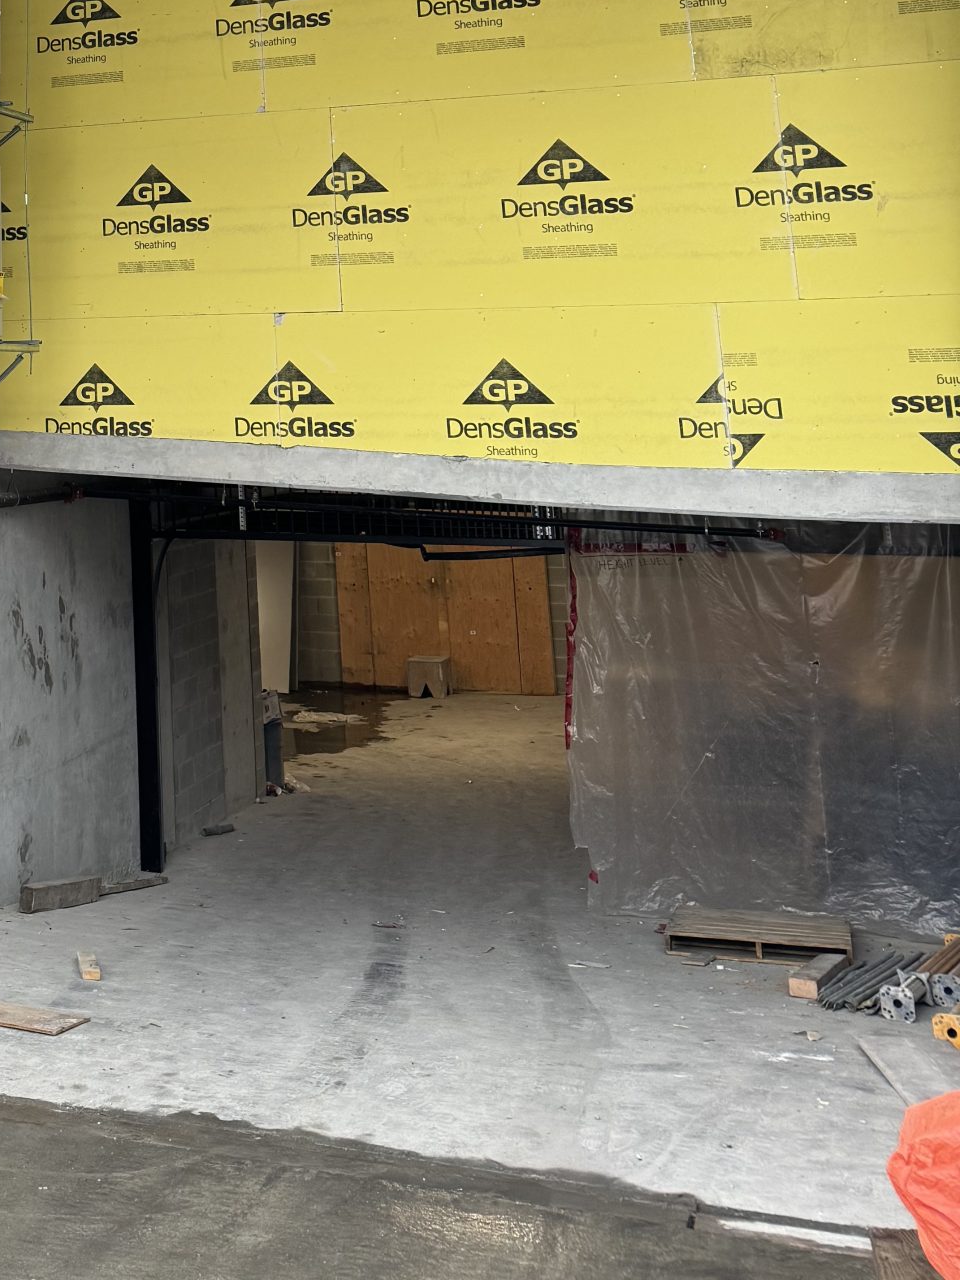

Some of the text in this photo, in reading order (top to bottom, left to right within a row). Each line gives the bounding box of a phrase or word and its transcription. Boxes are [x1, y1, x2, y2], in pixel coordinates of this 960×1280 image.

[65, 0, 103, 21] GP
[216, 10, 331, 37] DensGlass
[454, 15, 503, 29] Sheathing
[37, 30, 138, 54] DensGlass
[66, 53, 107, 65] Sheathing
[773, 144, 819, 166] GP
[536, 158, 584, 180] GP
[325, 170, 366, 192] GP
[132, 182, 172, 203] GP
[735, 183, 873, 208] DensGlass
[292, 205, 409, 228] DensGlass
[501, 194, 633, 219] DensGlass
[103, 216, 210, 236] DensGlass
[541, 221, 594, 234] Sheathing
[134, 239, 176, 250] Sheathing
[75, 382, 115, 404] GP
[267, 380, 312, 402] GP
[482, 379, 529, 402] GP
[45, 418, 153, 437] DensGlass
[235, 418, 355, 438] DensGlass
[446, 417, 578, 440] DensGlass
[486, 445, 538, 458] Sheathing
